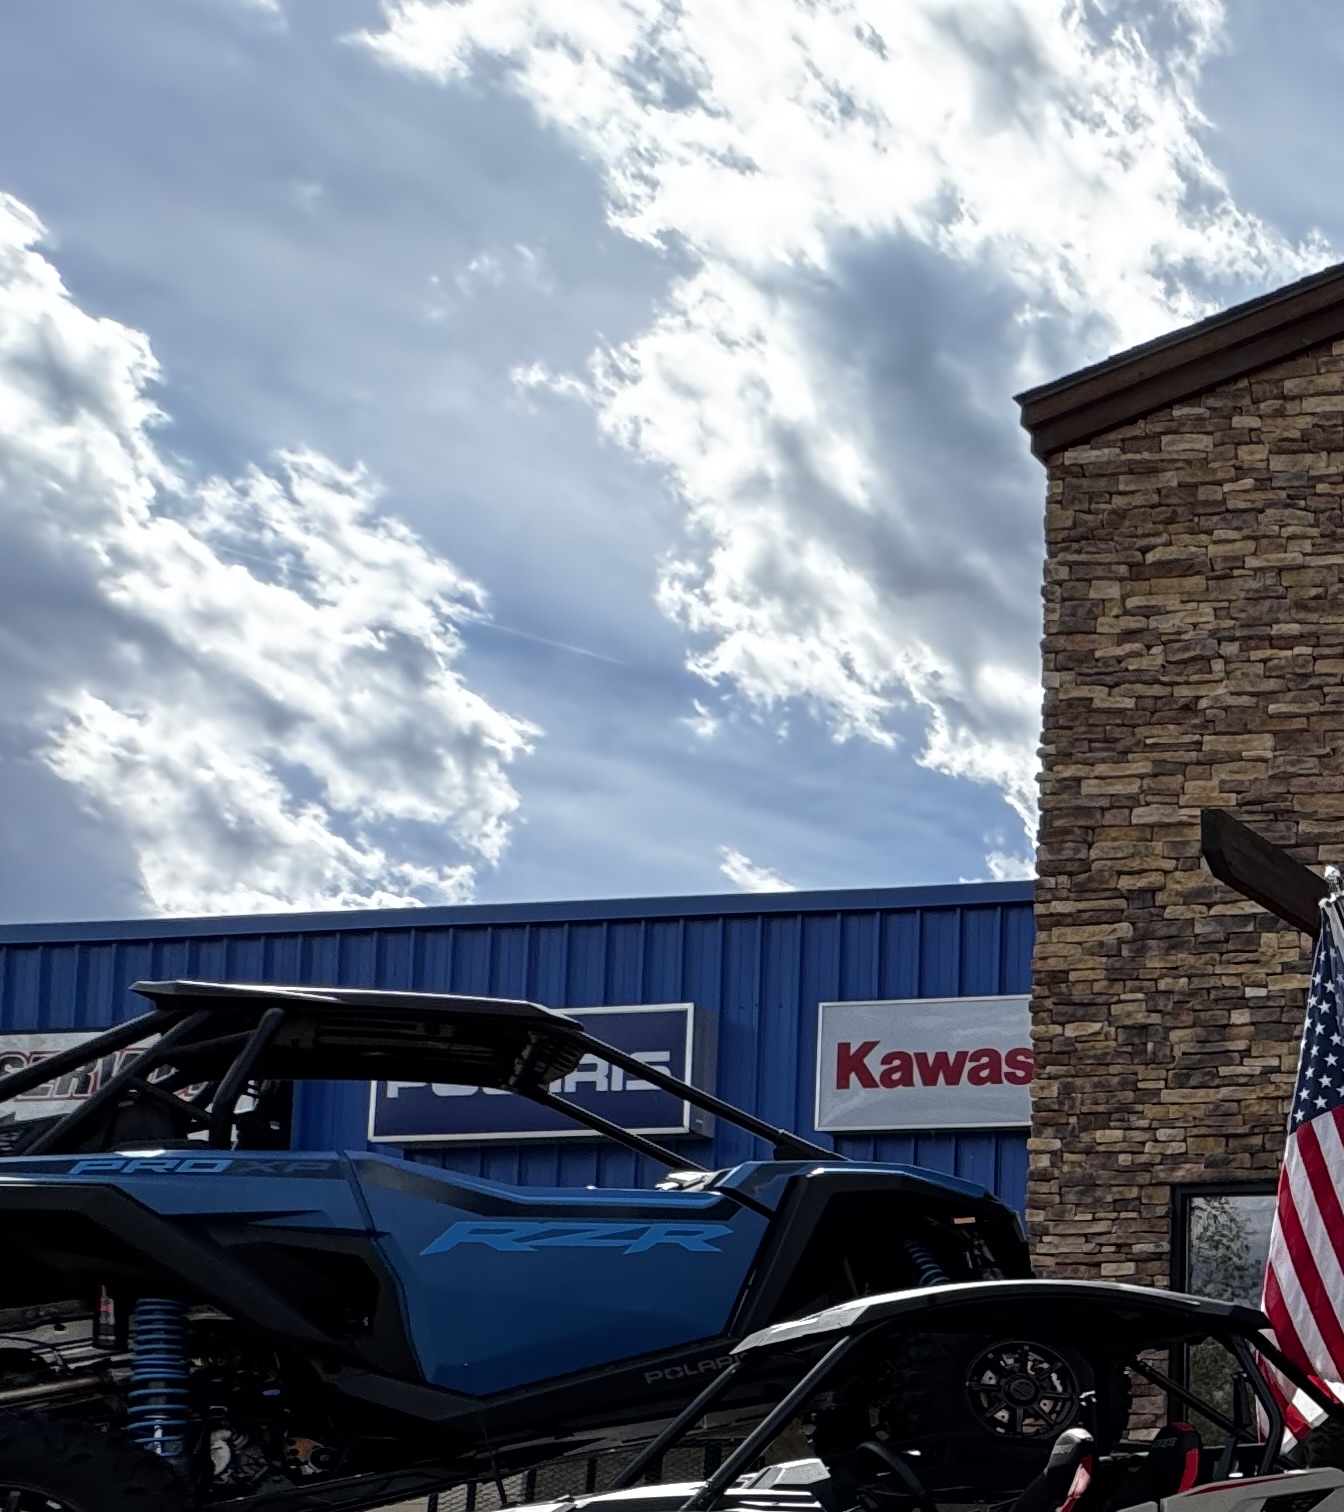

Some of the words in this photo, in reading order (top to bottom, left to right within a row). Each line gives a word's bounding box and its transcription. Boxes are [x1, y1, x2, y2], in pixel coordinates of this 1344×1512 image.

[836, 1040, 1034, 1090] Kawas
[68, 1159, 232, 1175] PRO
[418, 1220, 735, 1255] RZR
